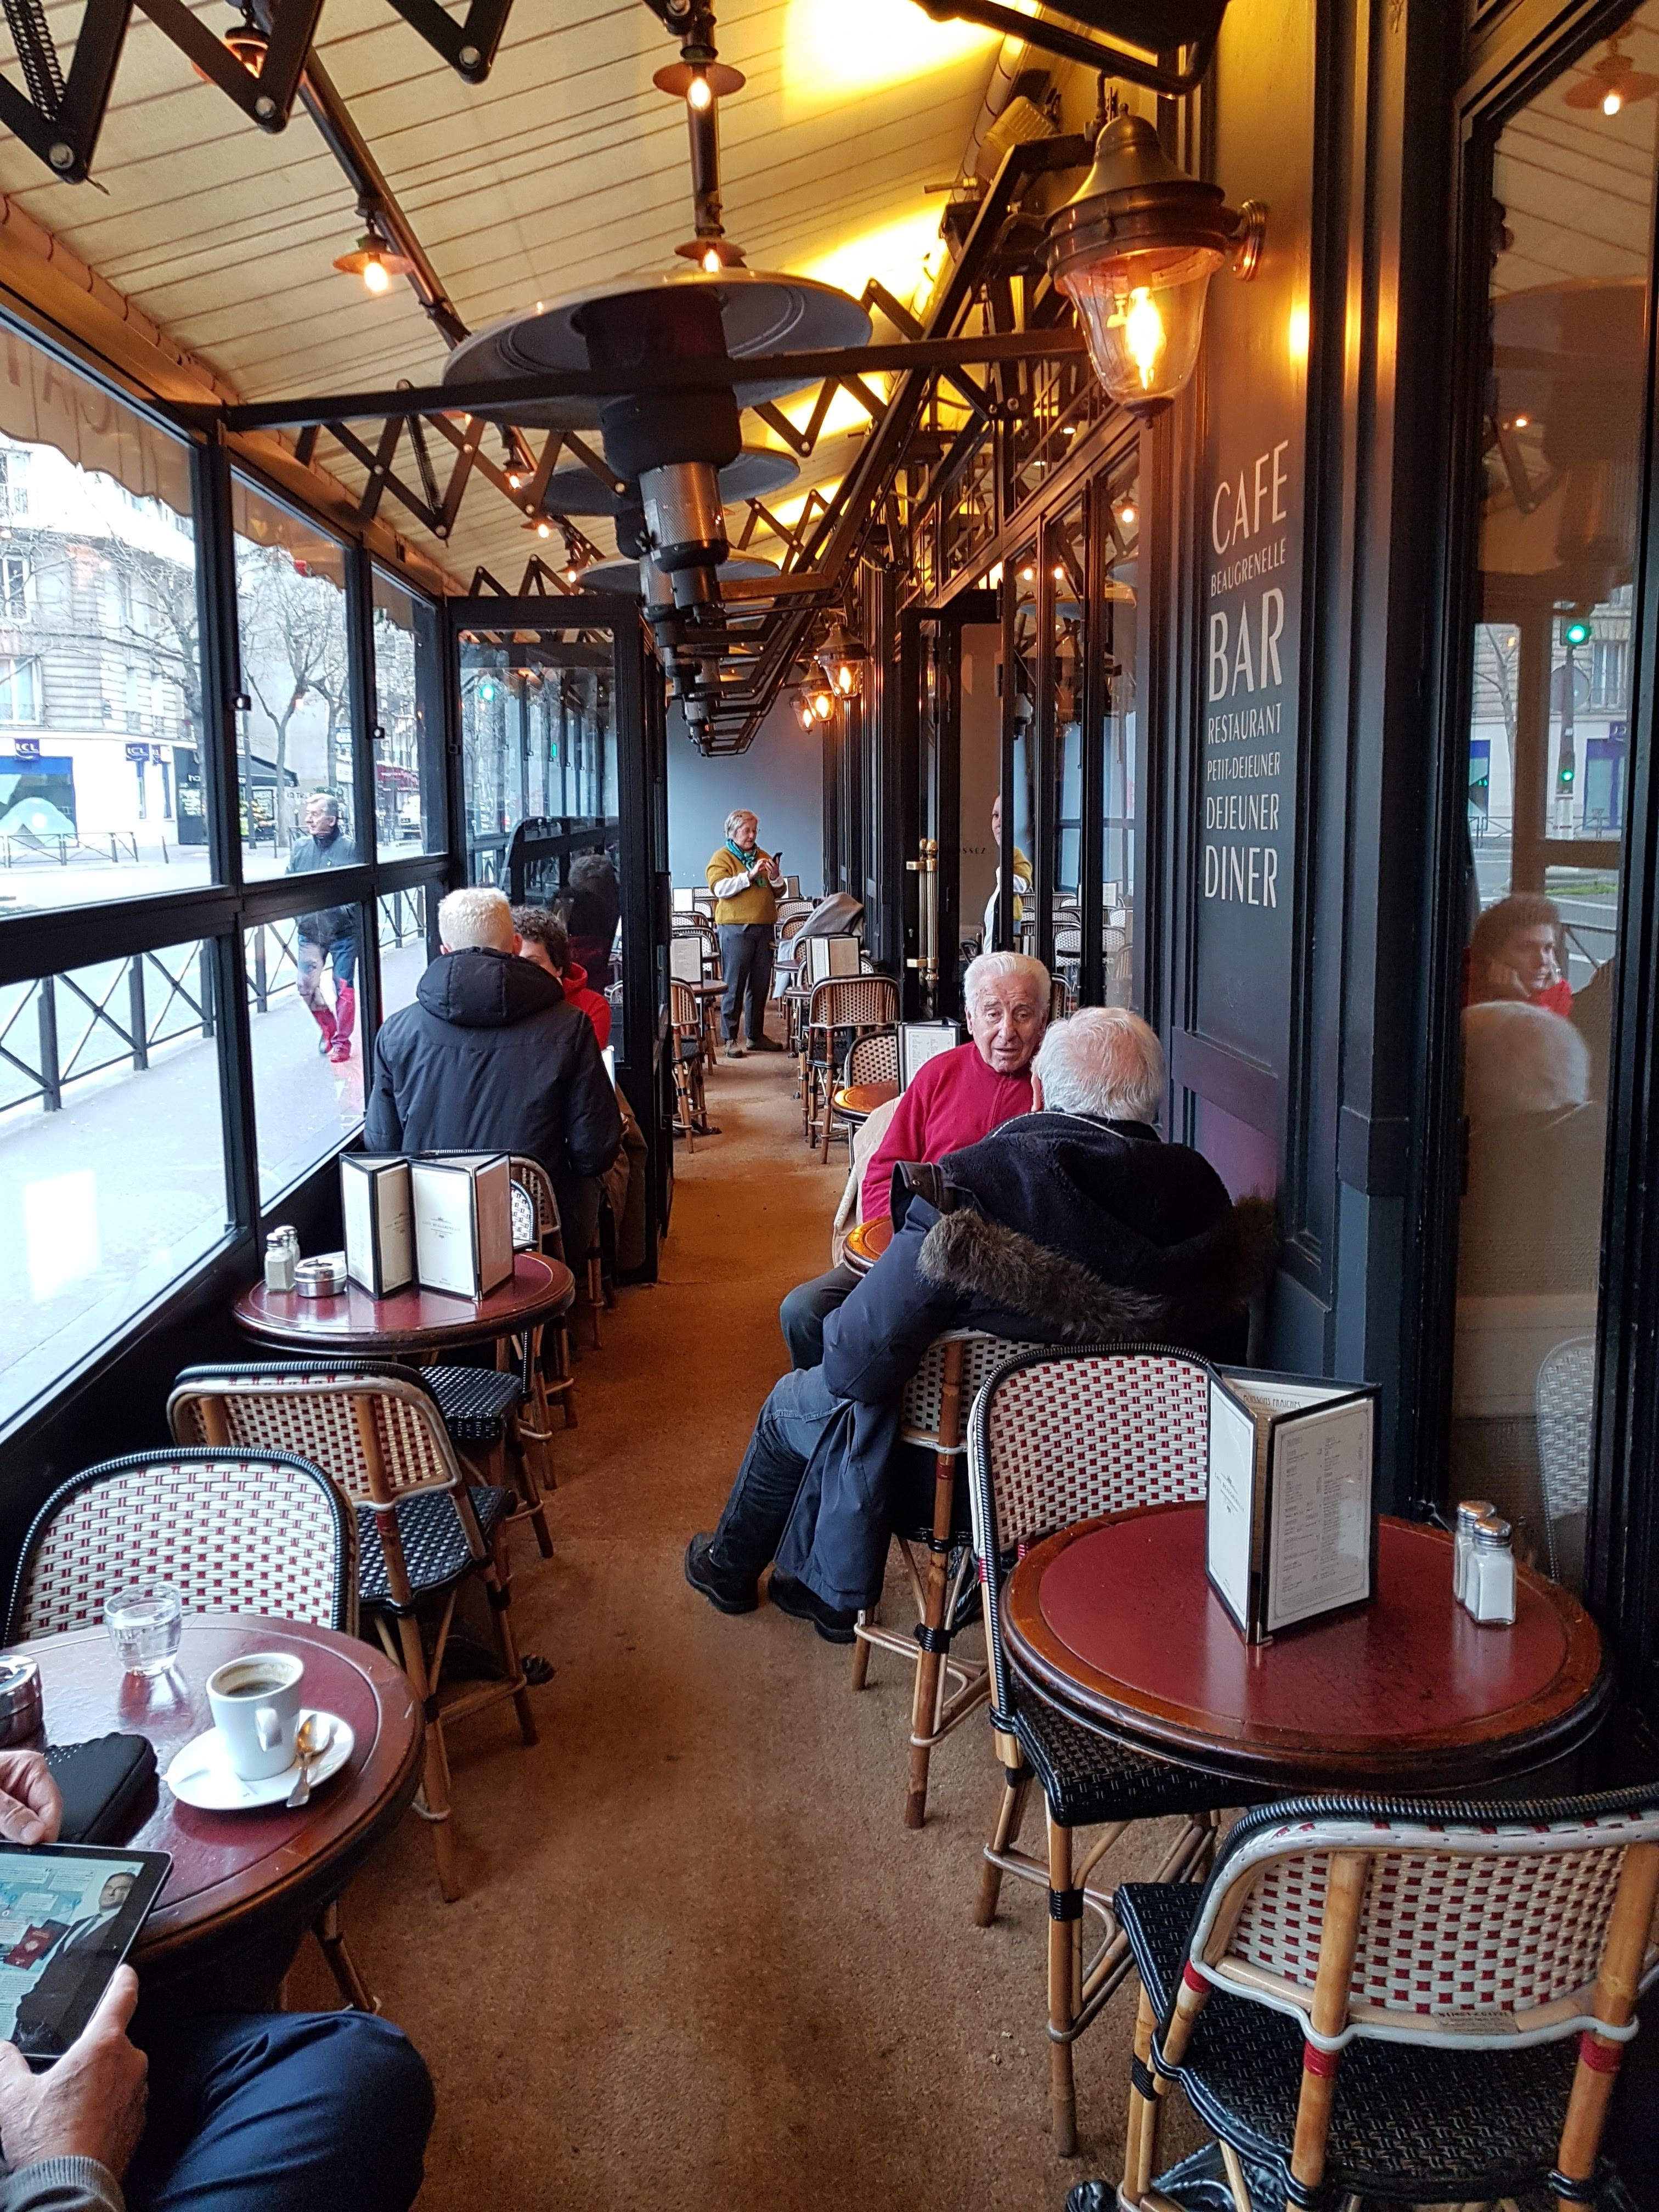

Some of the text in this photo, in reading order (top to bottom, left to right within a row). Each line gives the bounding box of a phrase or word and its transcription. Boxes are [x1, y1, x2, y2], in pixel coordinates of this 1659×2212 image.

[1212, 439, 1289, 555] CAFE
[1210, 538, 1286, 598] BEAUGRENELLE
[1209, 588, 1284, 702] BAR
[16, 743, 38, 752] LCL
[1208, 703, 1282, 745] RESTAURANT
[1206, 793, 1279, 831] DEJEUNER
[1205, 845, 1278, 909] DINER
[1243, 1394, 1271, 1406] BOISSONS
